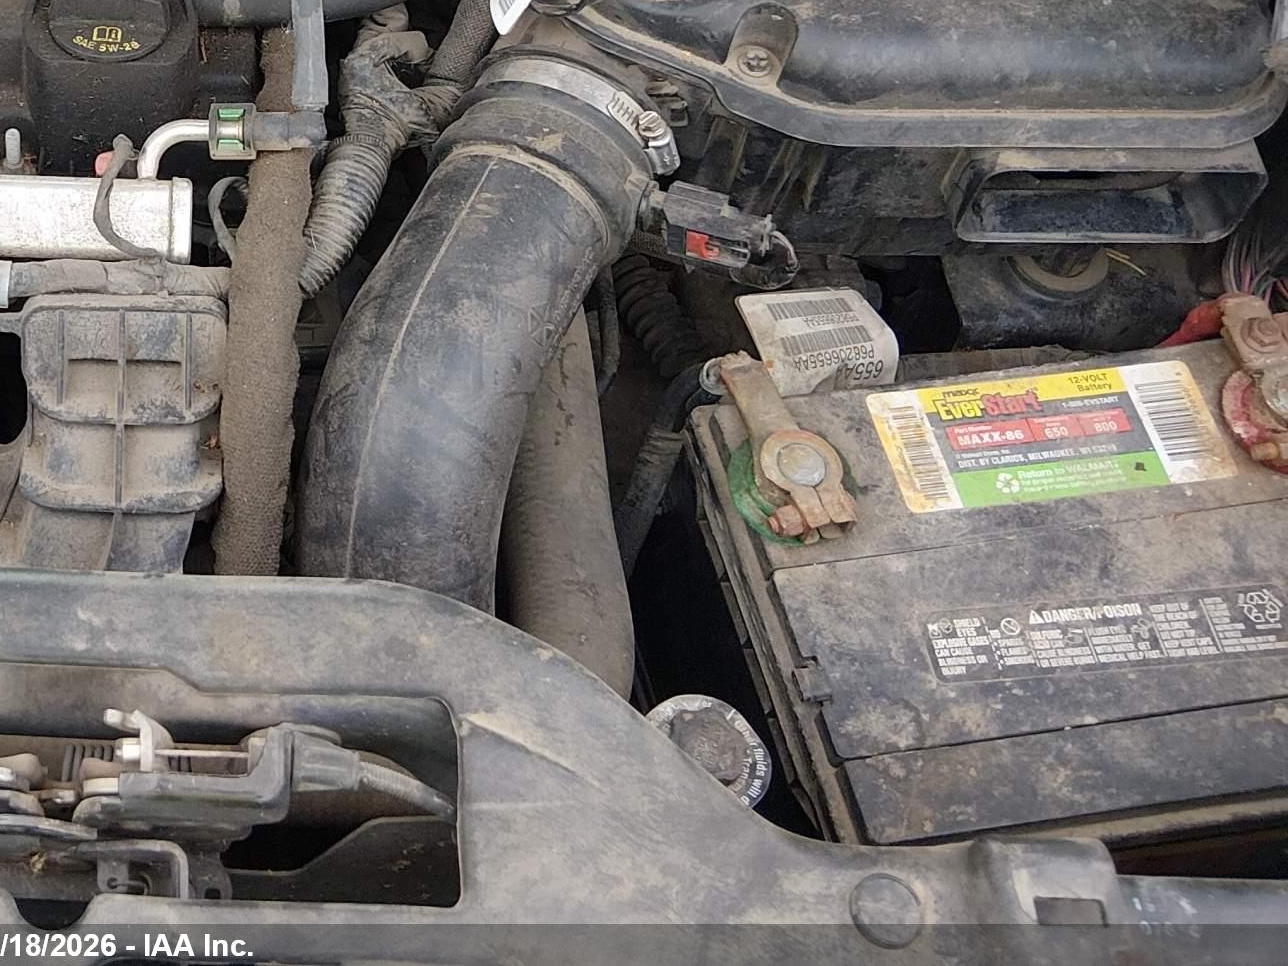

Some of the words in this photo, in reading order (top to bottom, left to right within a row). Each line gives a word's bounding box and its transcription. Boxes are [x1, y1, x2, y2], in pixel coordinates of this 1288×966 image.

[72, 35, 97, 50] SAE
[793, 344, 875, 372] P68206655AA
[1067, 372, 1108, 385] 12-VOLT
[1077, 382, 1112, 393] Battery
[1044, 426, 1069, 438] 650
[1041, 603, 1142, 622] DANGER/POISON
[753, 748, 769, 777] fluids
[747, 778, 764, 799] will
